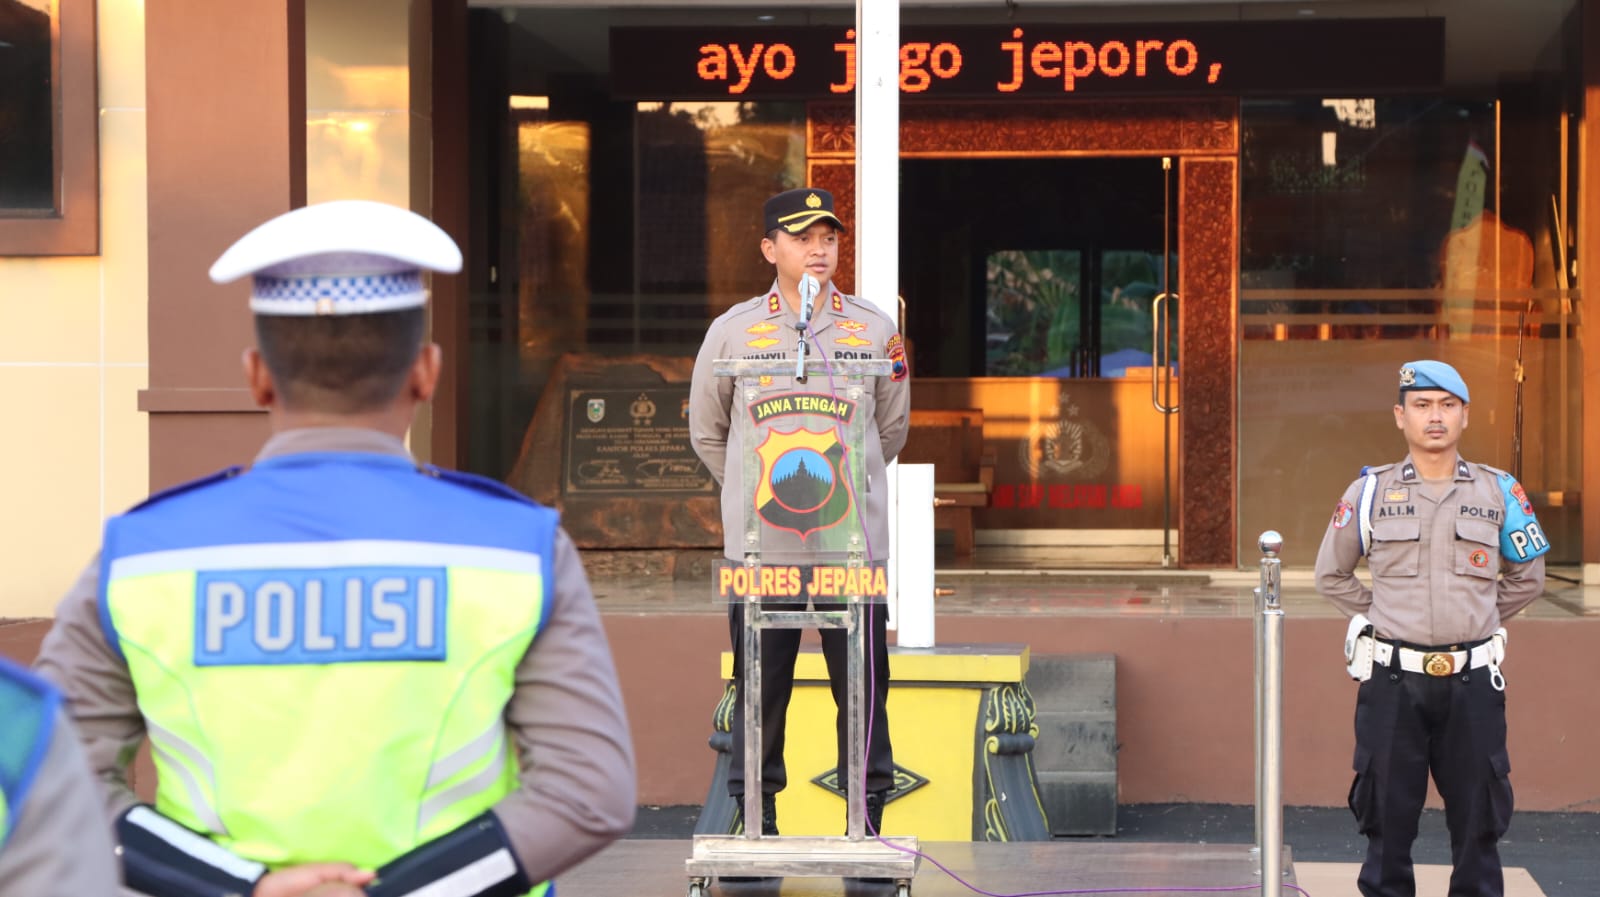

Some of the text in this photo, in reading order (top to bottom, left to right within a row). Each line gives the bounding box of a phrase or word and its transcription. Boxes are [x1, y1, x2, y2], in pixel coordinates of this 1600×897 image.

[697, 27, 1222, 93] ayo jgo jeporo,
[756, 397, 848, 418] JAWA TENGAH
[1379, 505, 1415, 518] ALI.M
[1460, 505, 1500, 521] POLRI
[719, 566, 888, 596] POLRES JEPARA
[205, 577, 435, 653] POLISI
